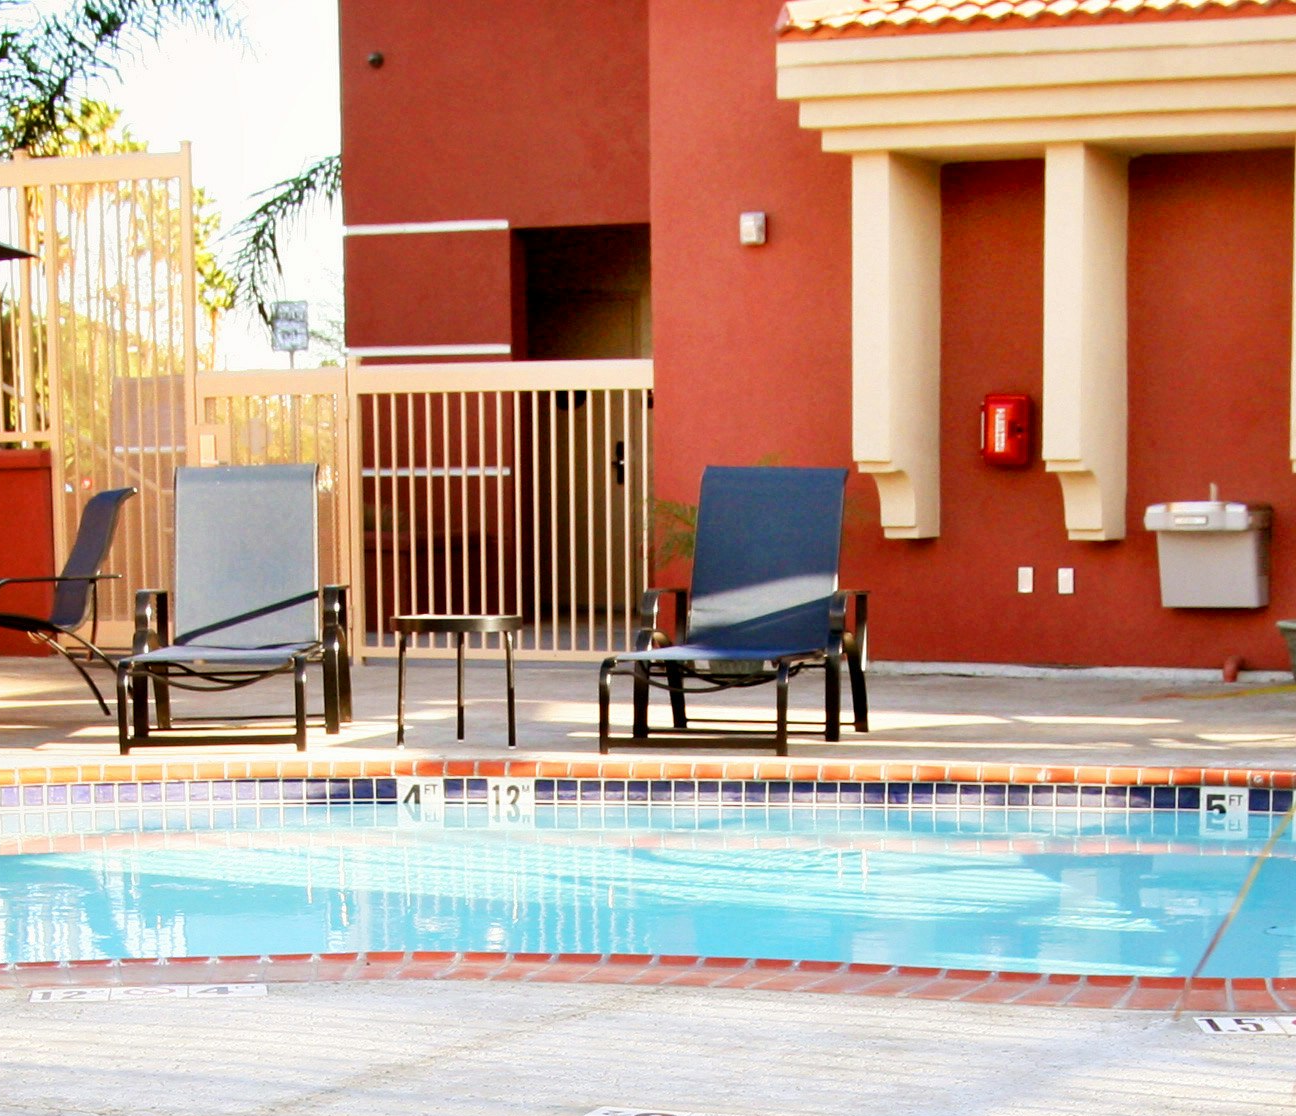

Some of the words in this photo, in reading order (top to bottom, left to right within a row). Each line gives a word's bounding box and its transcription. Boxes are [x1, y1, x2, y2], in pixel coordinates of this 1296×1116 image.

[424, 784, 438, 794] FT
[522, 784, 531, 793] M
[1206, 794, 1226, 814] 5
[1229, 794, 1243, 806] FT
